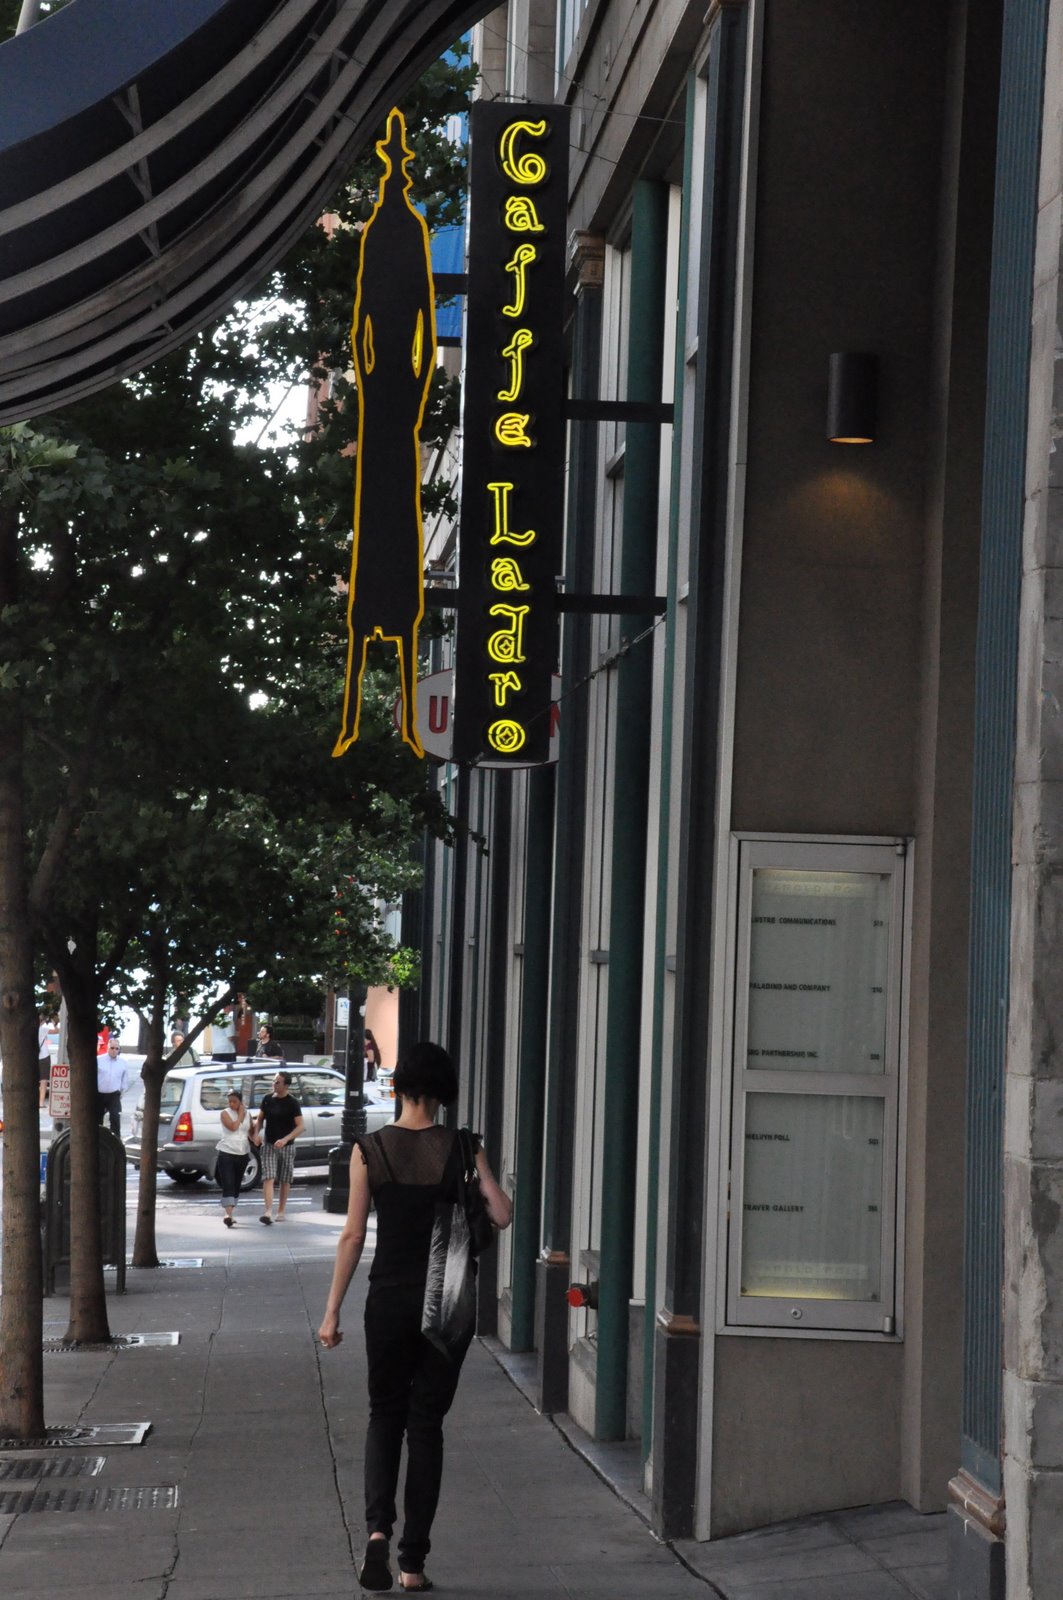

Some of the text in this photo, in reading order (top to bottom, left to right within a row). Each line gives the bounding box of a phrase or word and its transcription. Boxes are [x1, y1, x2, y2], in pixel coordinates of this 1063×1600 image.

[487, 121, 545, 752] Caffe Ladro
[779, 917, 837, 926] COMMUNICATIONS
[749, 982, 831, 992] PALADINO AND COMPANY
[761, 1049, 805, 1058] PARTNERSHIP
[53, 1067, 67, 1077] NO
[53, 1080, 70, 1089] STO
[774, 1134, 791, 1142] POLL
[743, 1204, 804, 1213] TRAVER GALLERY
